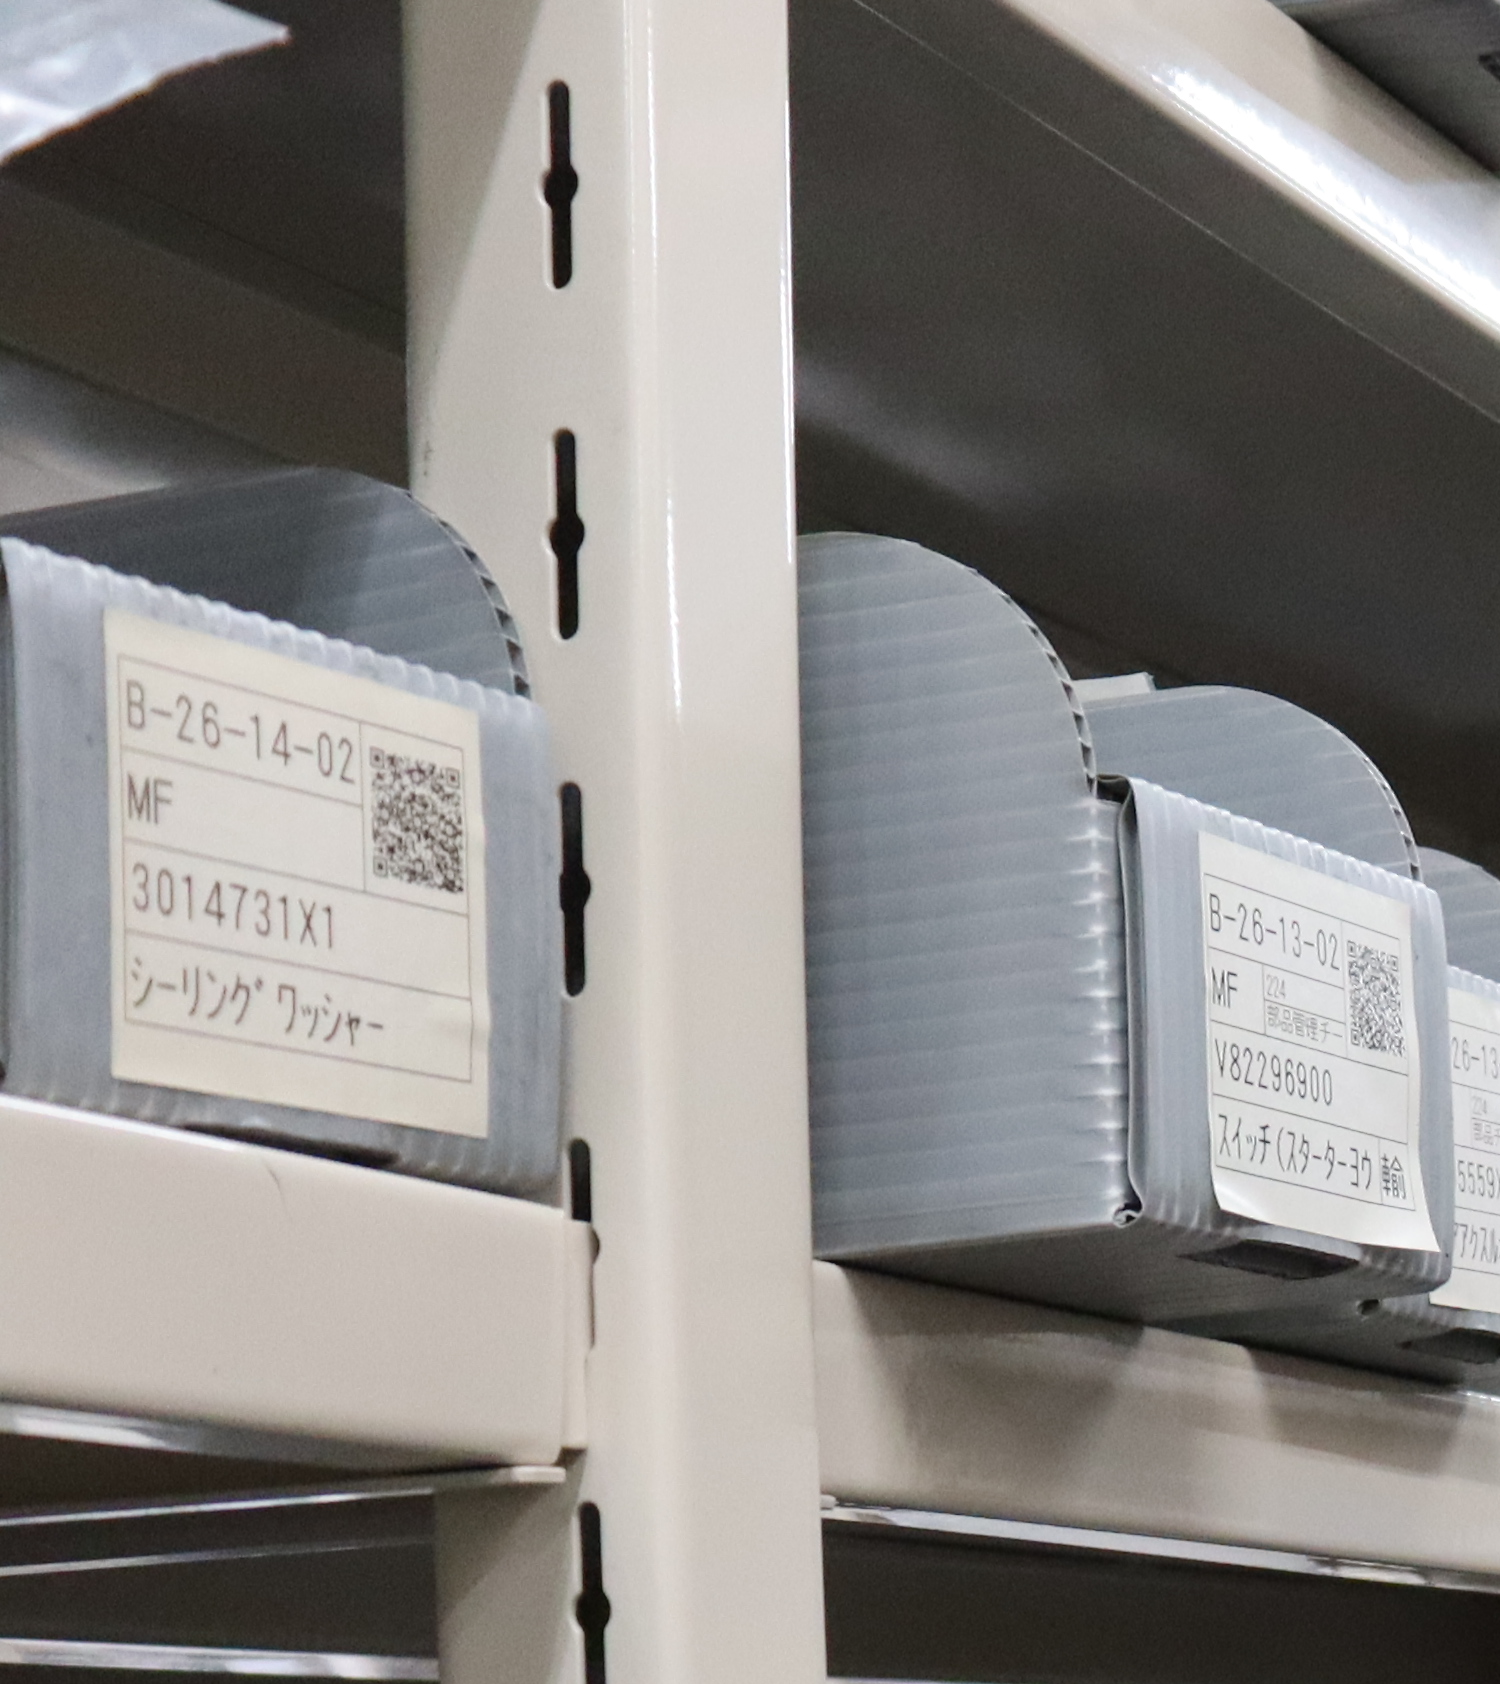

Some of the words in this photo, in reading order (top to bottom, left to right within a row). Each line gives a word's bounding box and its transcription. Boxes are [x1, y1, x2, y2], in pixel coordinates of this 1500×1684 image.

[125, 679, 357, 786] B-26-14-02
[126, 774, 174, 825] MF
[131, 862, 337, 950] 3014731X1
[1207, 892, 1342, 973] B-26-13-02
[1210, 965, 1239, 1009] MF
[1266, 973, 1288, 1000] 224
[1214, 1037, 1334, 1107] V82296900
